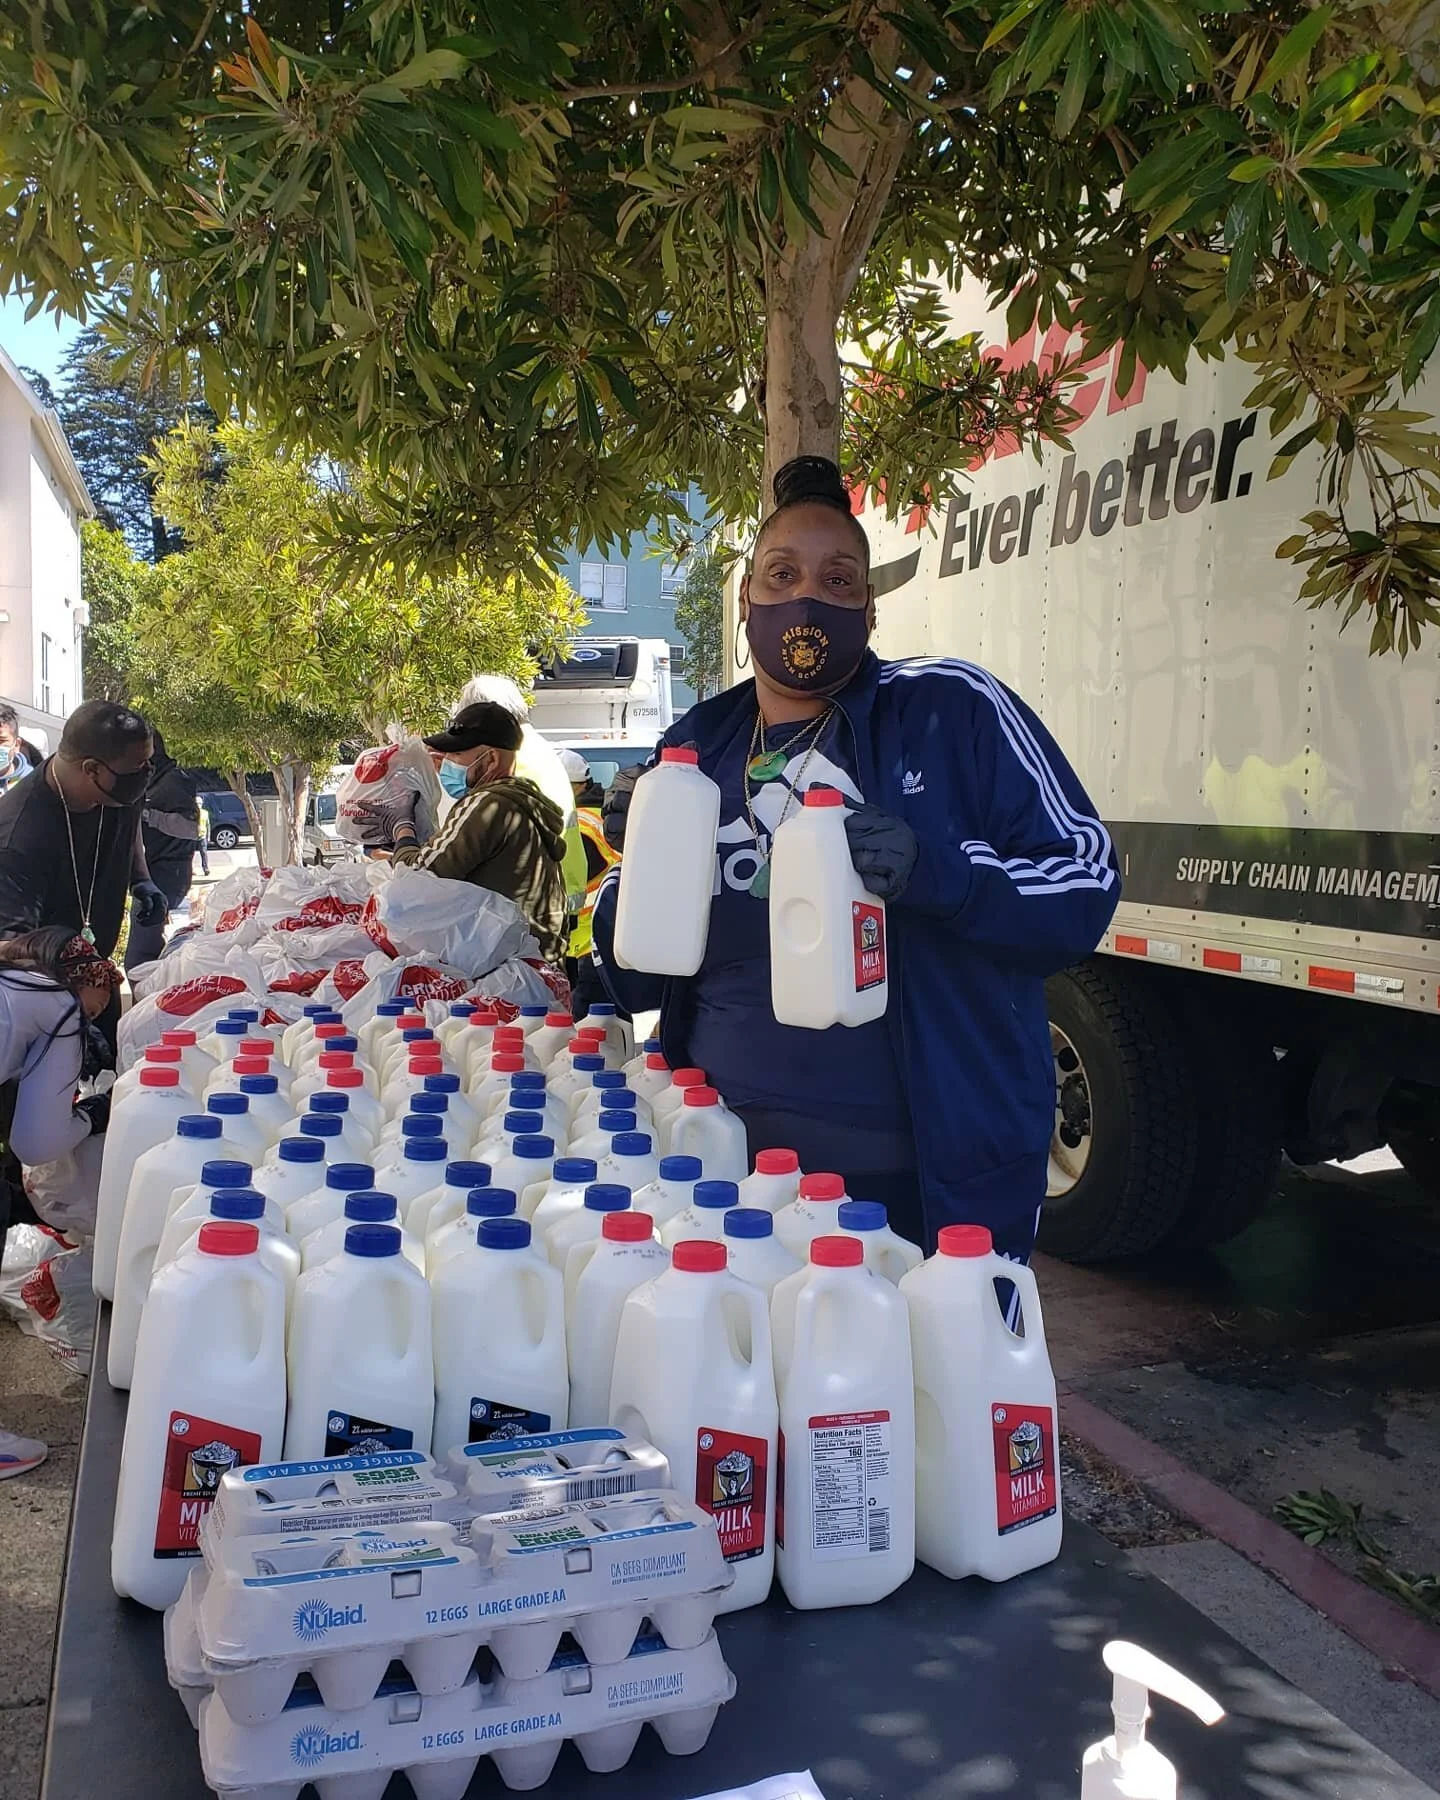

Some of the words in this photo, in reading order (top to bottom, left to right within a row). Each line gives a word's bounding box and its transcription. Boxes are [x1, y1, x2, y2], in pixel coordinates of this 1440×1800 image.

[939, 483, 1045, 578] Ever
[1050, 411, 1257, 547] better.
[782, 626, 829, 648] MISSION
[782, 648, 796, 674] HIGH
[798, 651, 828, 679] SCHOOL
[633, 707, 658, 716] 672588
[1176, 857, 1244, 886] SUPPLY
[1248, 862, 1311, 893] CHAIN
[1315, 866, 1440, 903] MANAGEM
[862, 950, 880, 970] MILK
[814, 1430, 843, 1439] Nutrition
[845, 1428, 862, 1437] Facts
[361, 1455, 414, 1467] LARGE
[848, 1448, 862, 1456] 160
[268, 1469, 289, 1477] AA
[300, 1461, 353, 1473] GRADE
[352, 1466, 417, 1482] EGGS
[1011, 1469, 1045, 1501] MILK
[179, 1502, 213, 1525] MI
[1012, 1495, 1040, 1515] VITAMIN
[1041, 1492, 1047, 1504] D
[712, 1505, 752, 1533] MILK
[178, 1527, 200, 1541] VITA
[515, 1529, 586, 1547] EGGS
[720, 1531, 744, 1549] TAMIN
[746, 1530, 753, 1542] D
[610, 1563, 621, 1578] CA
[622, 1560, 641, 1576] SEFS
[643, 1552, 686, 1572] COMPLIANT
[425, 1611, 437, 1623] 12
[441, 1605, 468, 1622] EGGS
[478, 1599, 512, 1617] LARGE
[514, 1592, 550, 1610] GRADE
[552, 1588, 567, 1601] AA
[608, 1686, 618, 1701] CA
[620, 1681, 638, 1699] SEFS
[640, 1672, 683, 1695] COMPLIANT
[422, 1735, 433, 1749] 12
[436, 1730, 464, 1747] EGGS
[474, 1722, 508, 1740] LARGE
[510, 1715, 546, 1734] GRADE
[548, 1712, 562, 1726] AA
